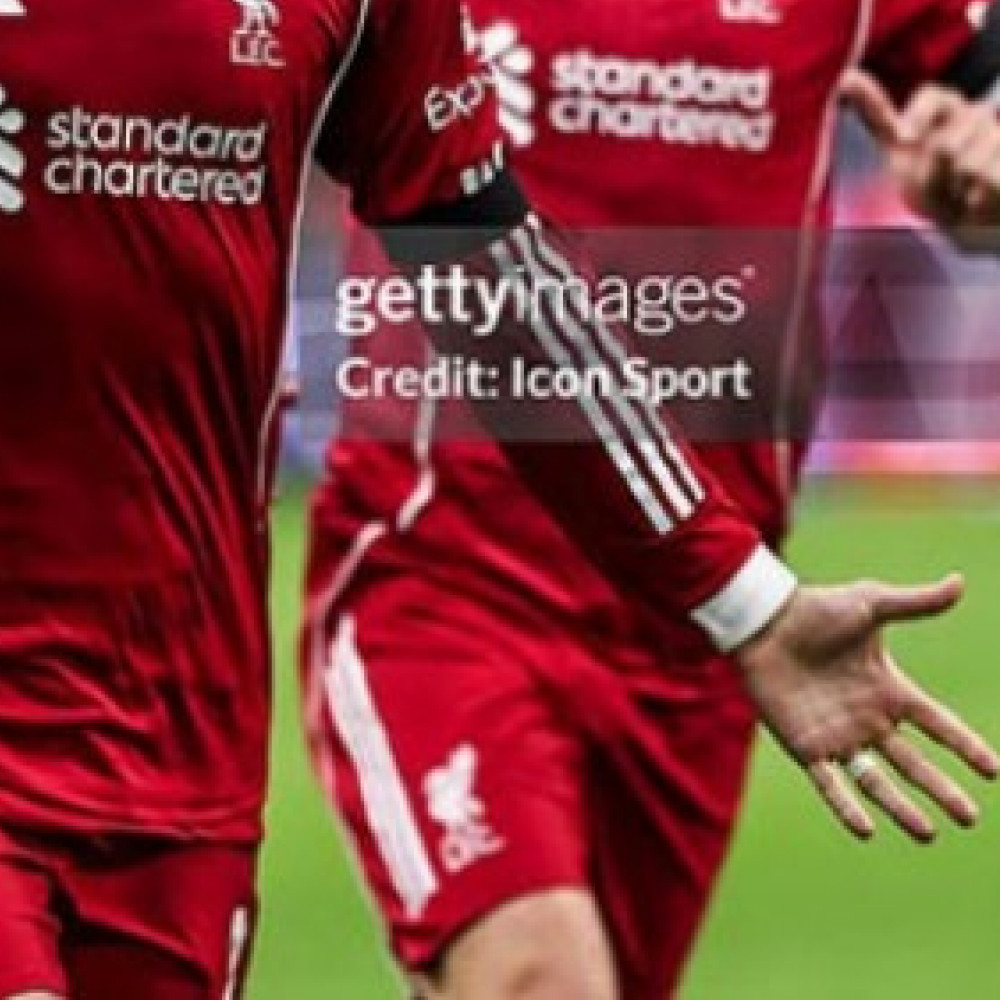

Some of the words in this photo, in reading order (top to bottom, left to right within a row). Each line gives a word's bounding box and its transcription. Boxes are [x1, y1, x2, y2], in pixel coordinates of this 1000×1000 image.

[552, 46, 773, 108] standard
[46, 105, 268, 163] standard
[548, 94, 774, 152] chartered
[43, 151, 265, 205] chartered
